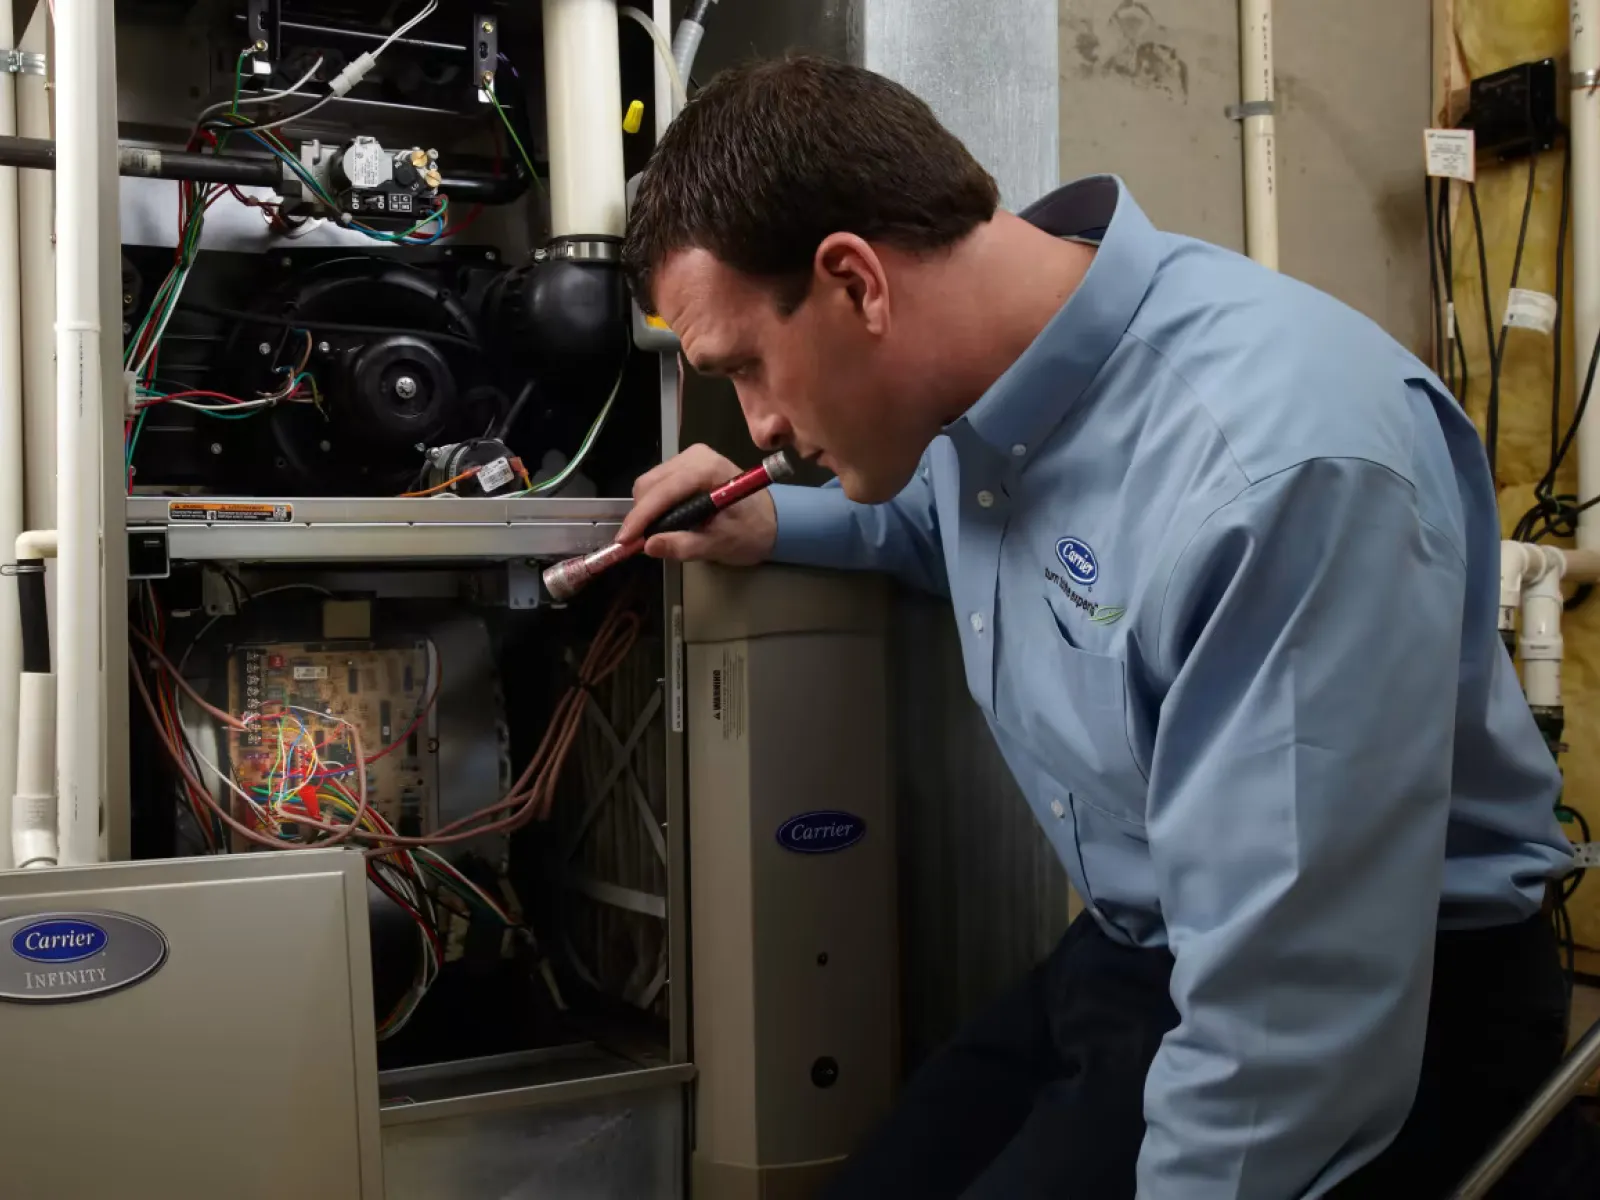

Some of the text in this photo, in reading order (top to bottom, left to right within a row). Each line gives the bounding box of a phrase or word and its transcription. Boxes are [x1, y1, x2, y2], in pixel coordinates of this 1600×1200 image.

[352, 193, 360, 209] OFF
[1063, 543, 1094, 575] Carrier
[713, 670, 721, 710] WARNING
[791, 822, 853, 841] Carrier
[26, 930, 95, 950] Carrier
[25, 968, 107, 989] INFINITY
